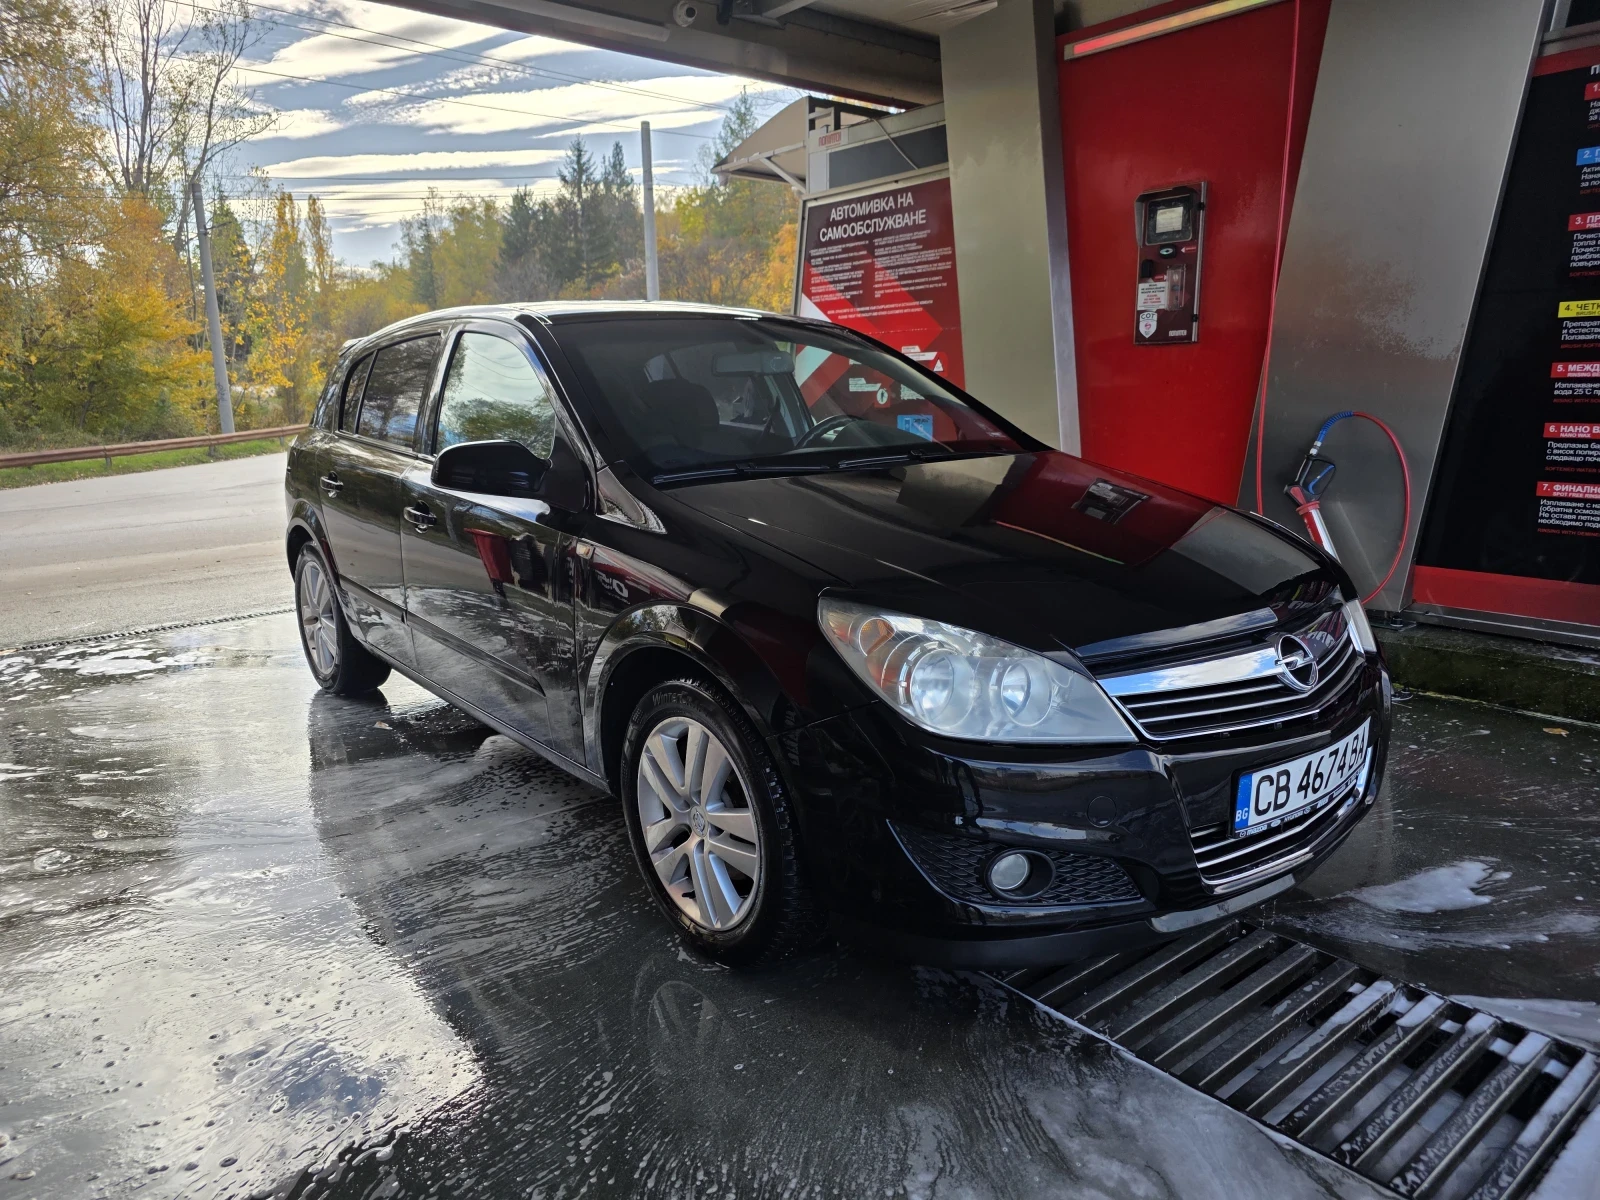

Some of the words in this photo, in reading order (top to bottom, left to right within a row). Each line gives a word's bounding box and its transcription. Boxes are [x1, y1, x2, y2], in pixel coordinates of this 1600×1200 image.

[1583, 150, 1592, 159] 2.
[829, 195, 896, 222] АВТОМИВКА
[897, 191, 914, 208] НА
[819, 208, 927, 242] САМООБСЛУЖВАНЕ
[1575, 216, 1584, 225] 3.
[1564, 304, 1573, 312] 4.
[1556, 364, 1566, 372] 5.
[1549, 425, 1558, 433] 6.
[1560, 425, 1590, 433] НАНО
[1542, 483, 1551, 491] 7.
[1540, 499, 1585, 508] Изплакване
[1537, 518, 1583, 527] необходимо
[1235, 807, 1250, 822] BG
[1254, 768, 1291, 817] CB
[1296, 742, 1349, 800] 4674
[1348, 727, 1366, 772] BA
